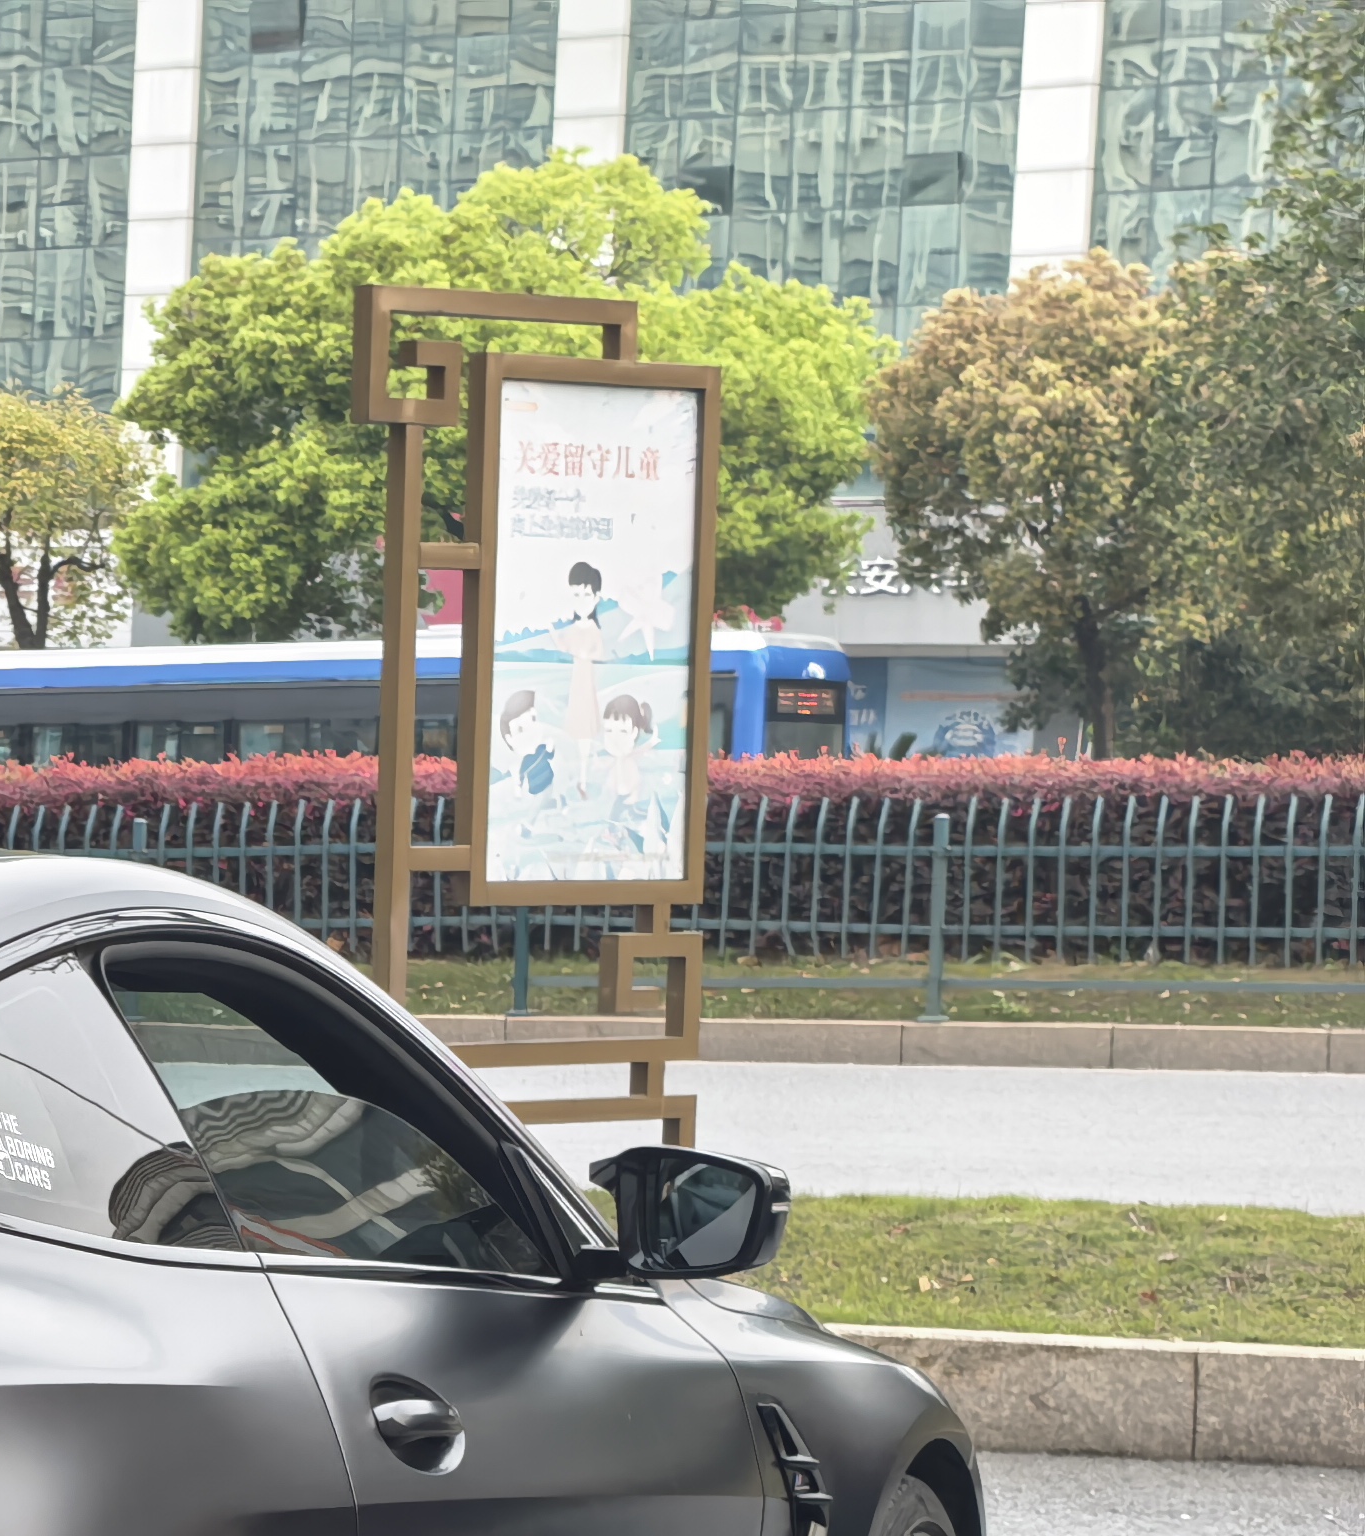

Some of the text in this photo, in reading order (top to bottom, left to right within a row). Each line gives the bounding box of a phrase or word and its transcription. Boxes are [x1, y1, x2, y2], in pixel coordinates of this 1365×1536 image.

[516, 440, 661, 481] 关爱留守儿童
[5, 1136, 55, 1168] BORING
[15, 1162, 52, 1190] CARS
